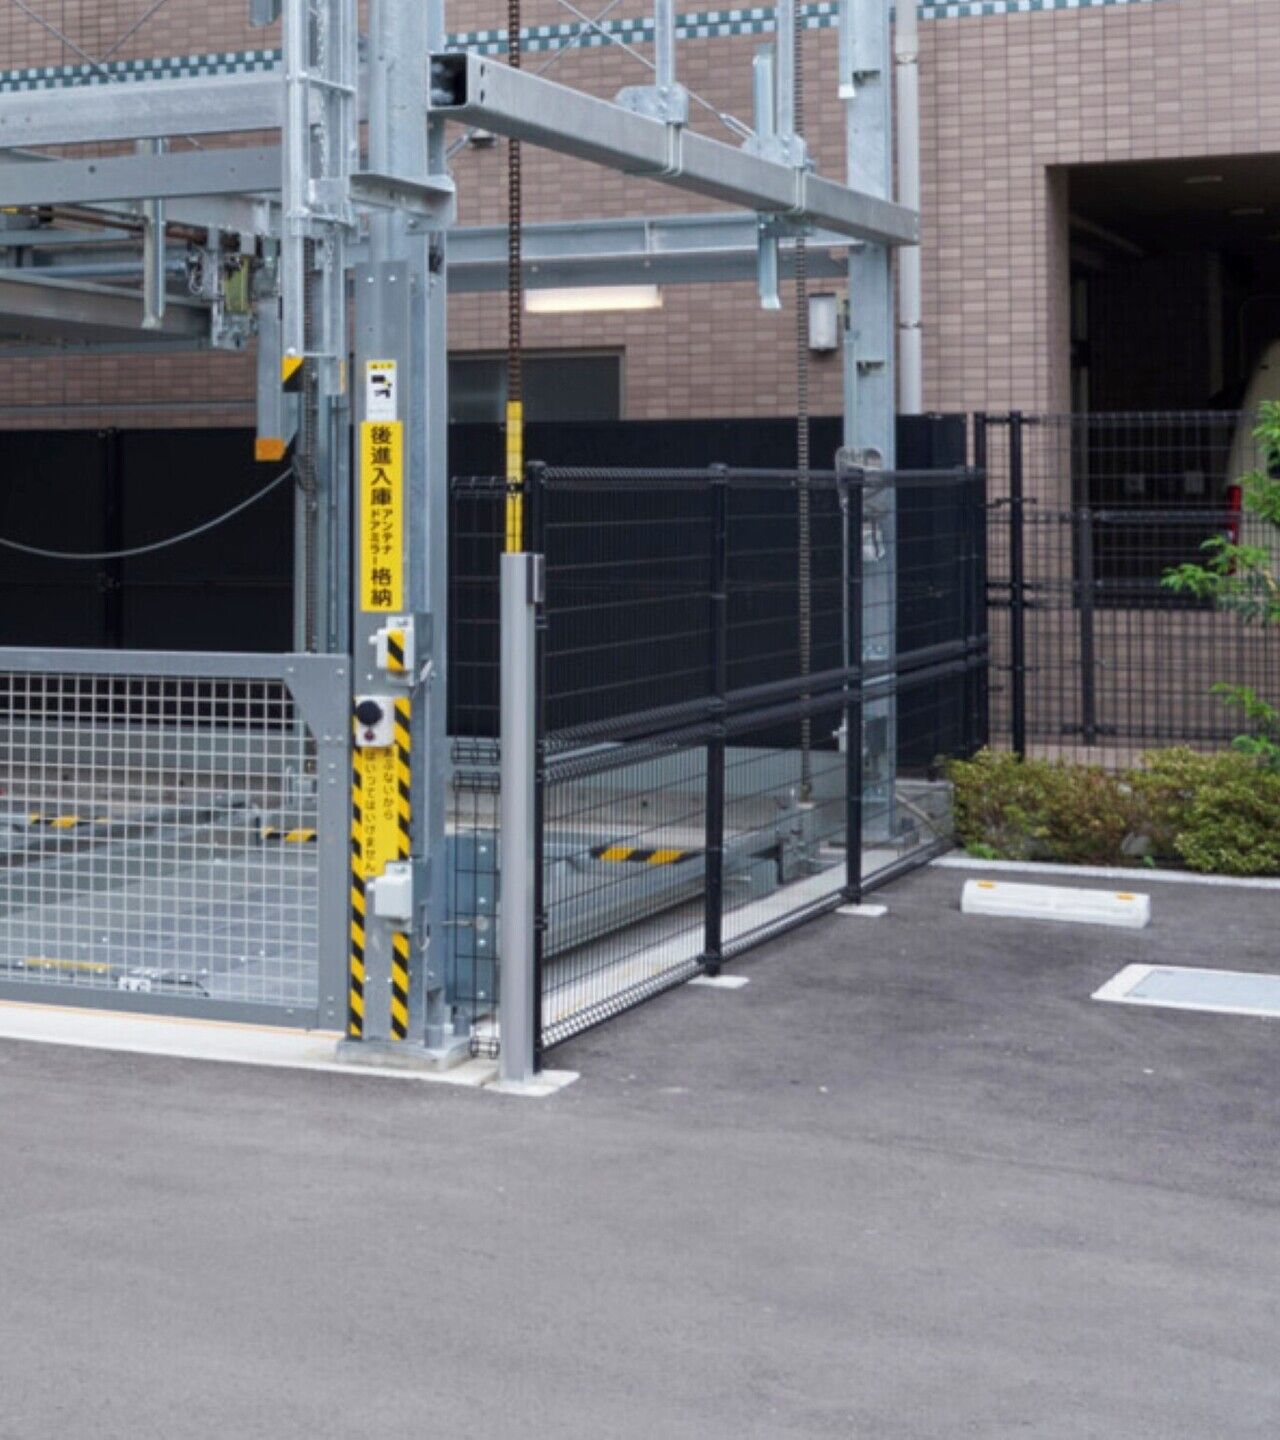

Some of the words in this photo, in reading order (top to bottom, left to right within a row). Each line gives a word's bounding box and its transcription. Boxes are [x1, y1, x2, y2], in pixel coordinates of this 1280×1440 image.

[370, 426, 393, 506] 後進入庫
[382, 508, 394, 555] アンテナ
[370, 567, 393, 607] 格納
